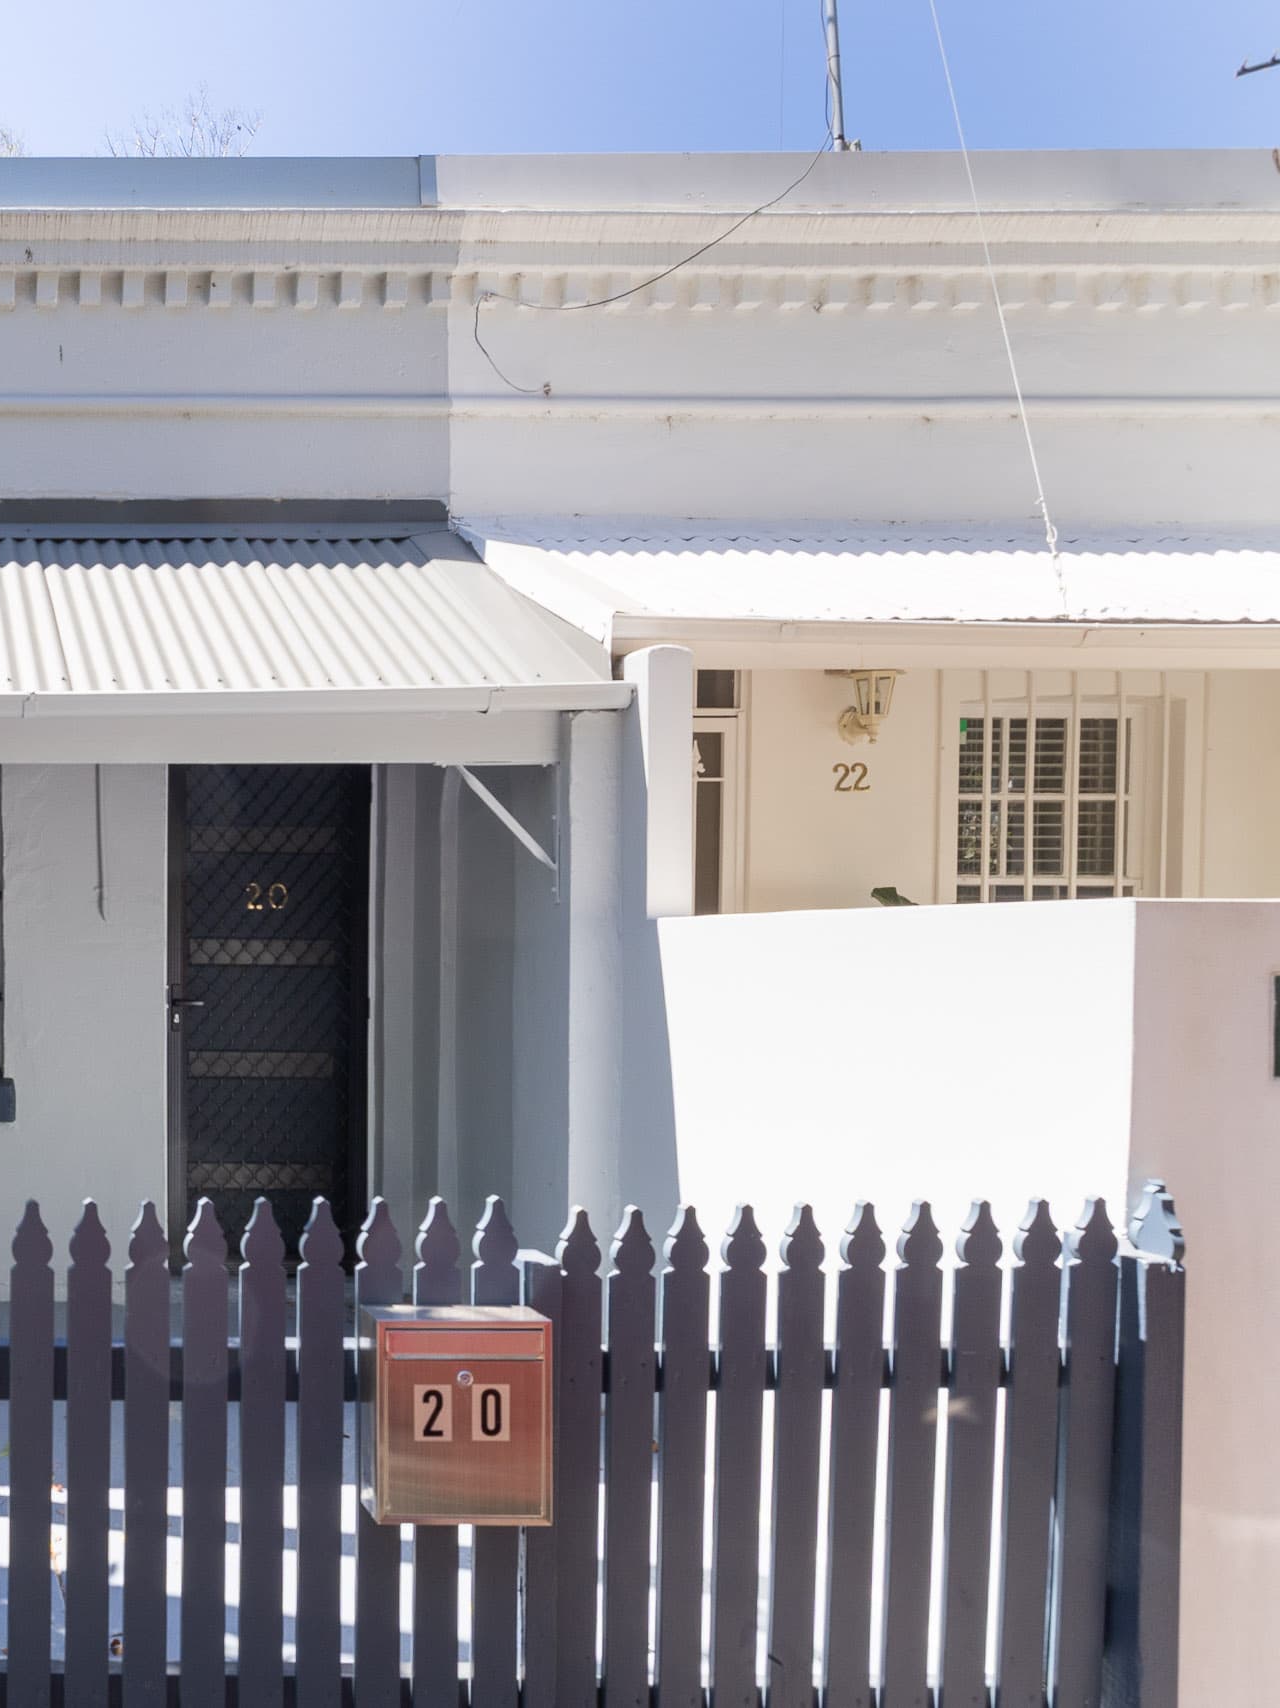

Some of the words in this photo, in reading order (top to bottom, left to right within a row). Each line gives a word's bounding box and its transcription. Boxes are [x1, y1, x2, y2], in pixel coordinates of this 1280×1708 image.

[832, 762, 871, 792] 22
[245, 882, 288, 910] 20
[422, 1388, 502, 1437] 20
